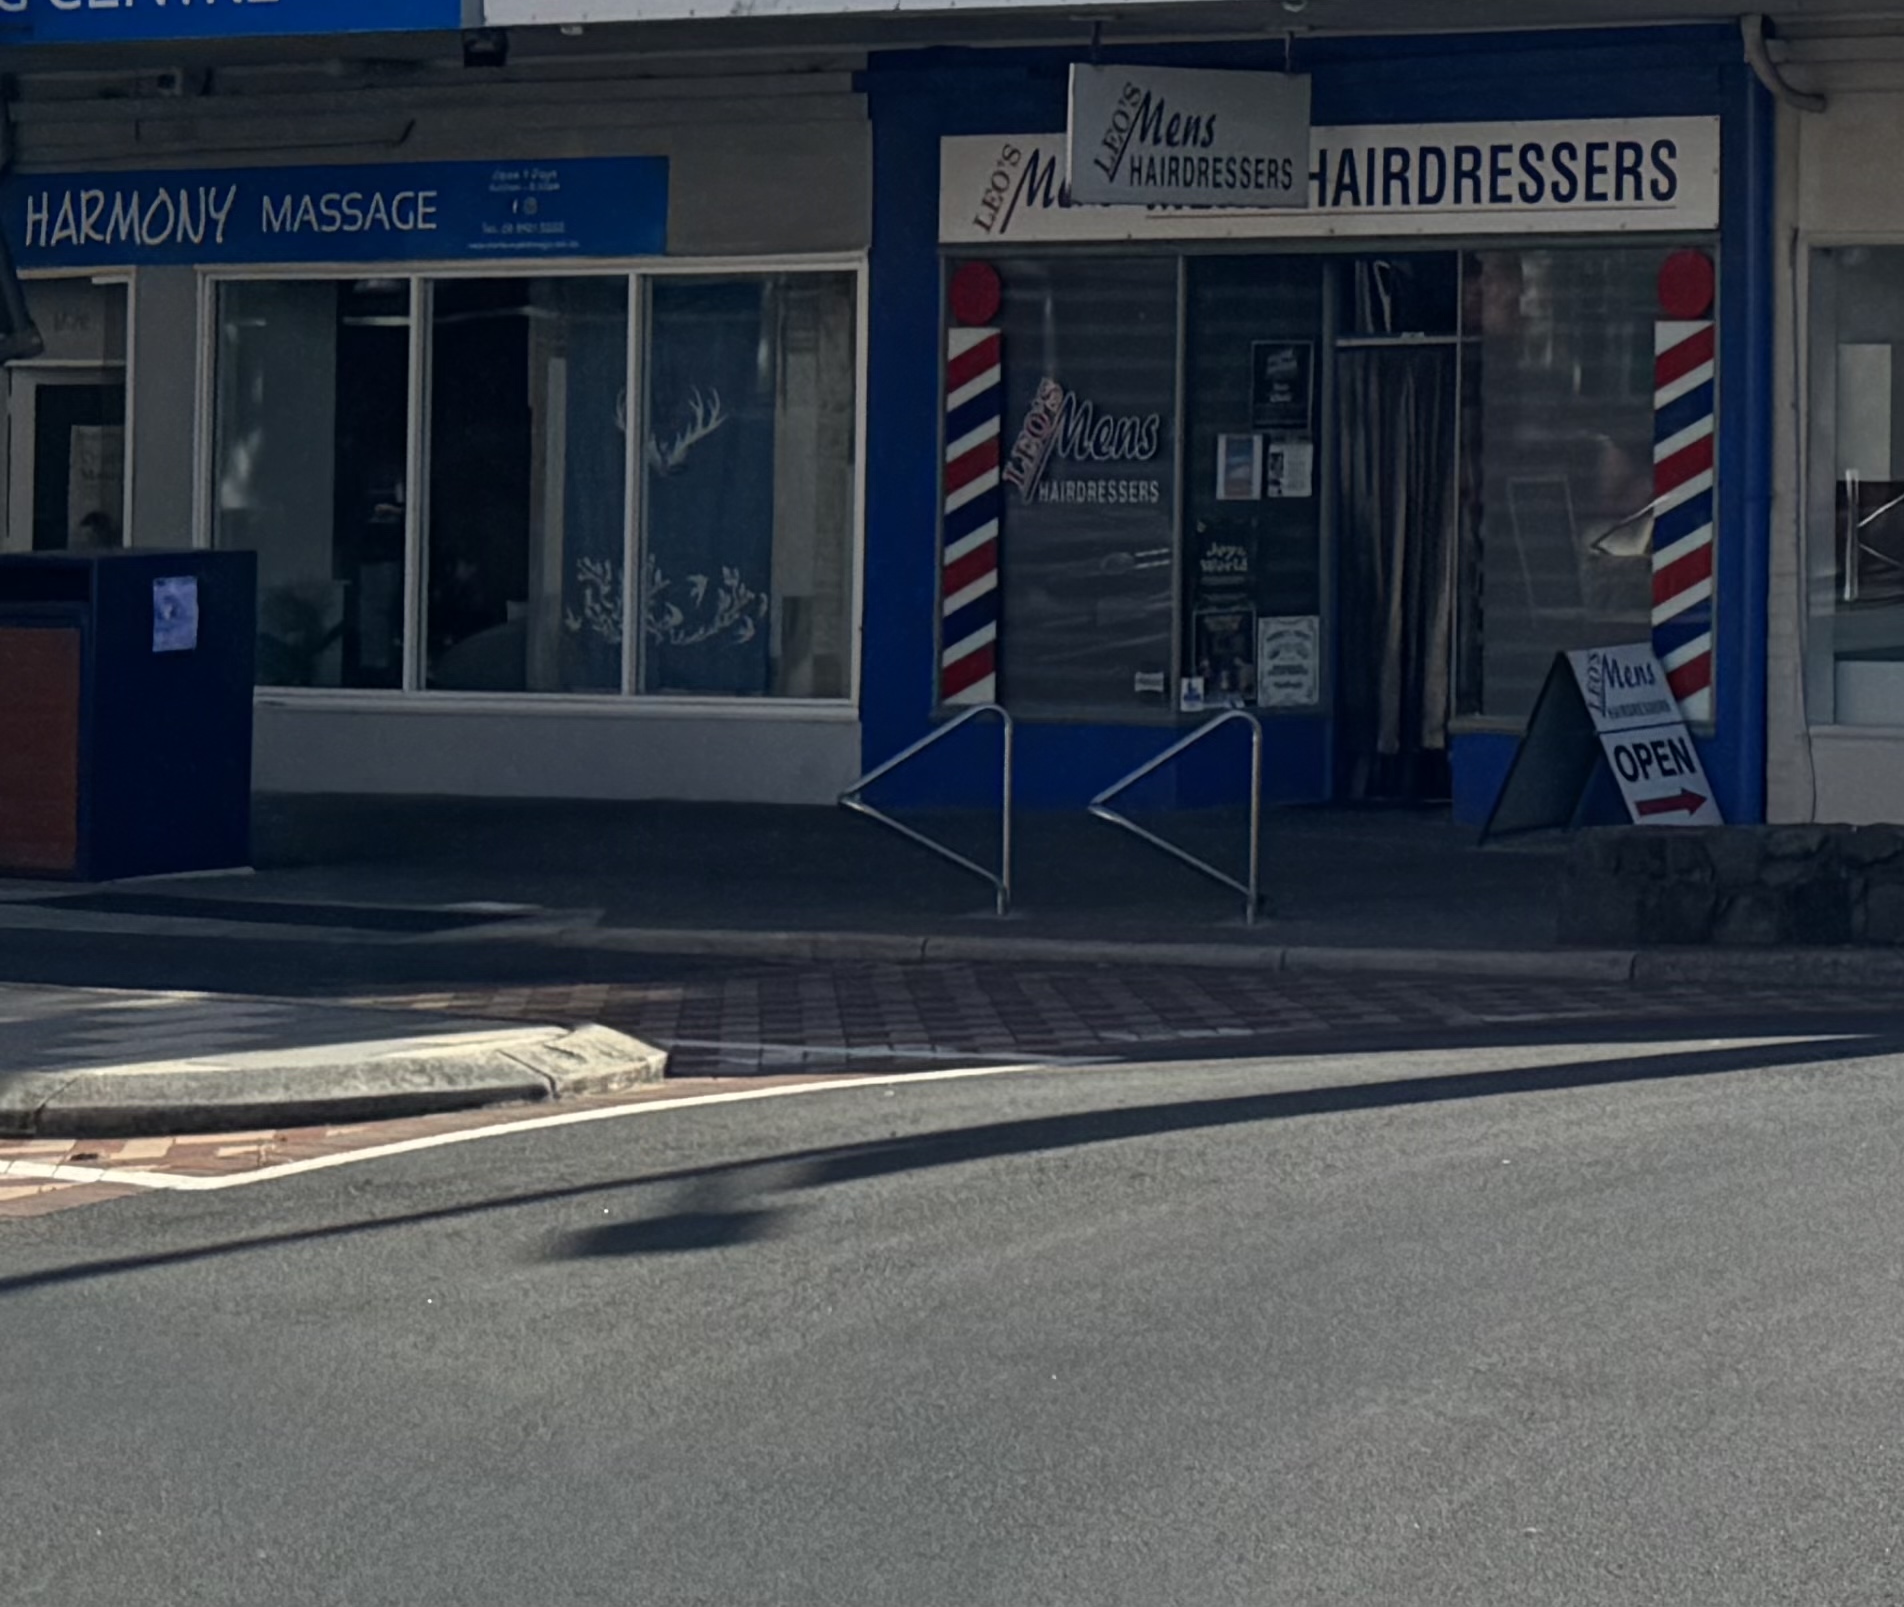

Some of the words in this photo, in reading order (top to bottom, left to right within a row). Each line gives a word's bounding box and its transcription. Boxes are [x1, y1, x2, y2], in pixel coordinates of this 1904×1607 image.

[1094, 81, 1141, 176] LEO'S
[1114, 91, 1216, 174] Mens
[973, 144, 1021, 233] LEO'S
[1130, 155, 1293, 190] HAIRDRESSERS
[25, 183, 237, 247] HARMONY
[262, 190, 438, 233] MASSAGE
[1028, 390, 1160, 492] Mens
[1038, 479, 1160, 503] HAIRDRESSERS
[1601, 654, 1656, 712] Mens
[1614, 737, 1696, 782] OPEN
